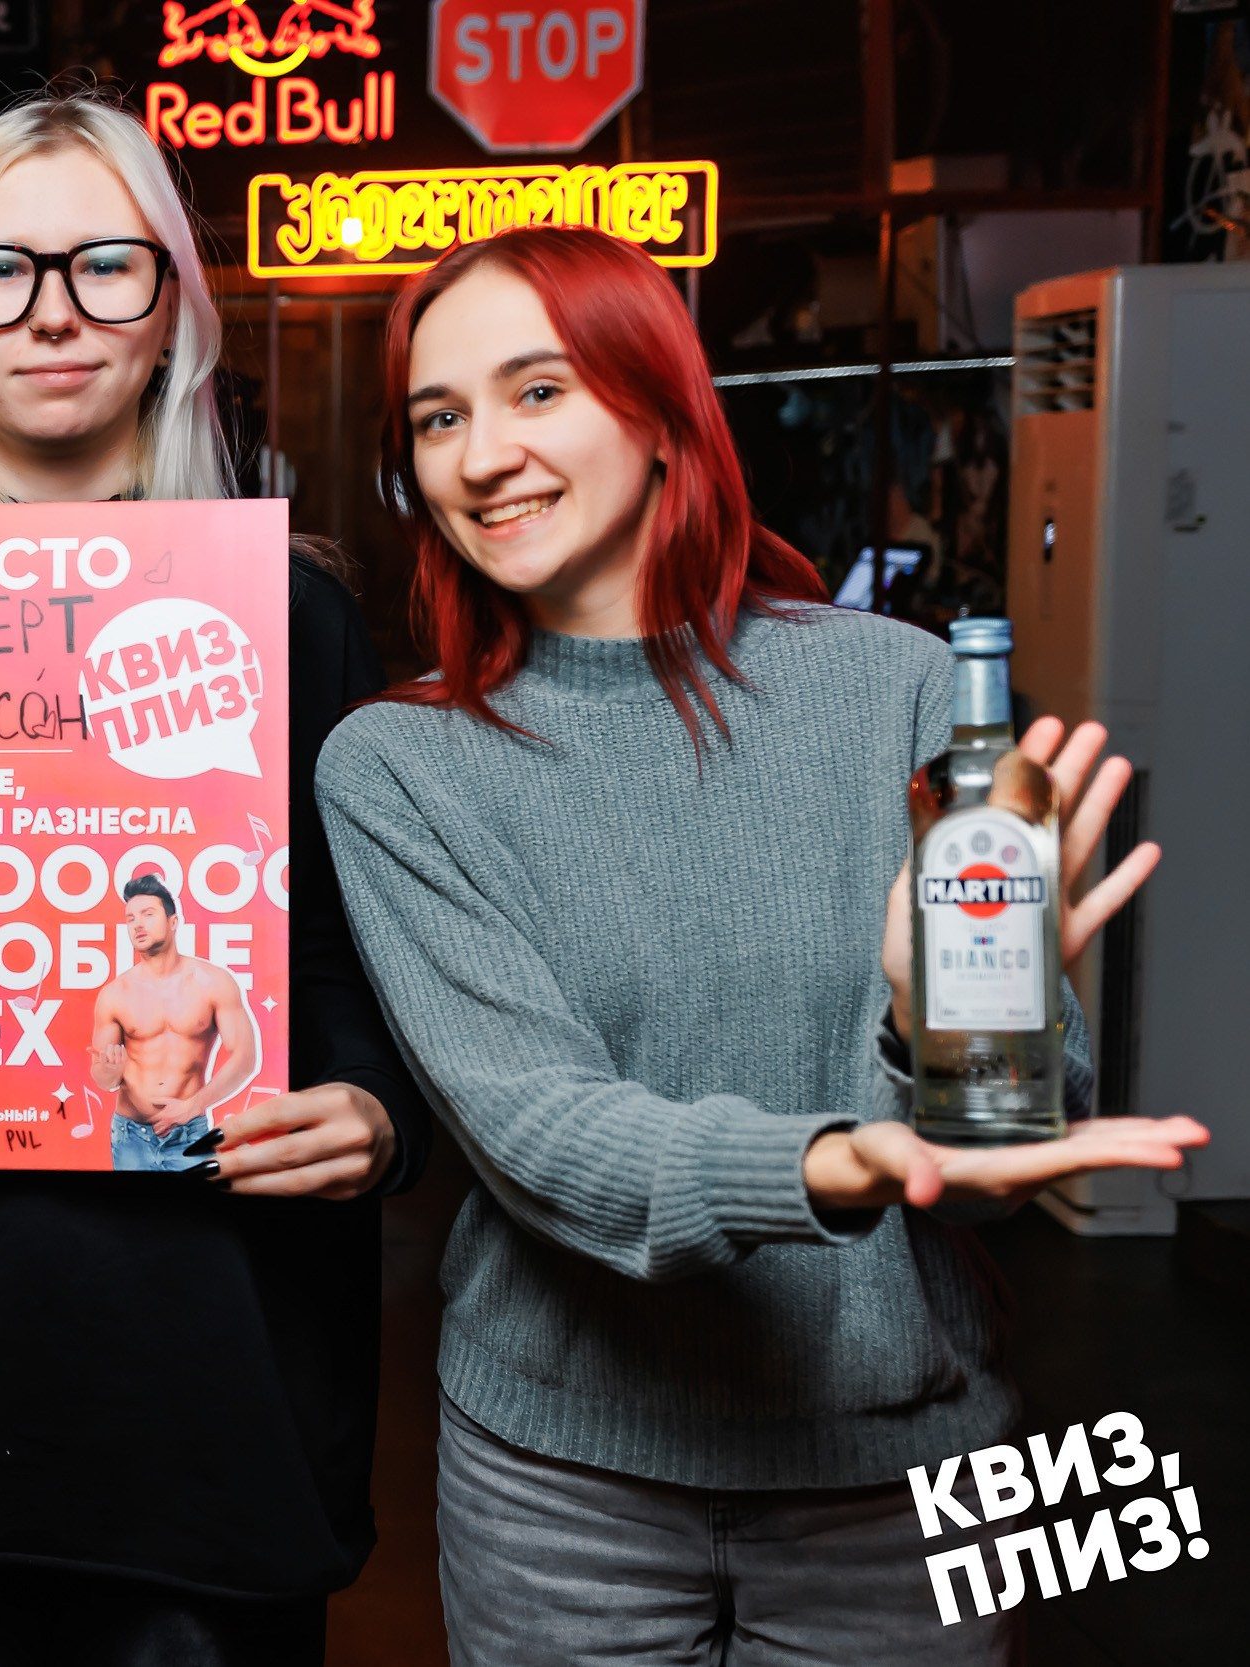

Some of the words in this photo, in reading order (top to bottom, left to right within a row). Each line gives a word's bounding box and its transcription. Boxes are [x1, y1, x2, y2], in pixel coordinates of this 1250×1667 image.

[455, 10, 627, 85] STOP
[146, 76, 267, 149] Red
[276, 71, 396, 144] Bull
[82, 619, 254, 702] КВИЗ,
[88, 666, 262, 755] ПЛИЗ!
[11, 806, 197, 834] РАЗНЕСЛА
[926, 879, 1042, 903] MARTINI
[939, 949, 1031, 970] BIANCO
[6, 1128, 42, 1152] PVL
